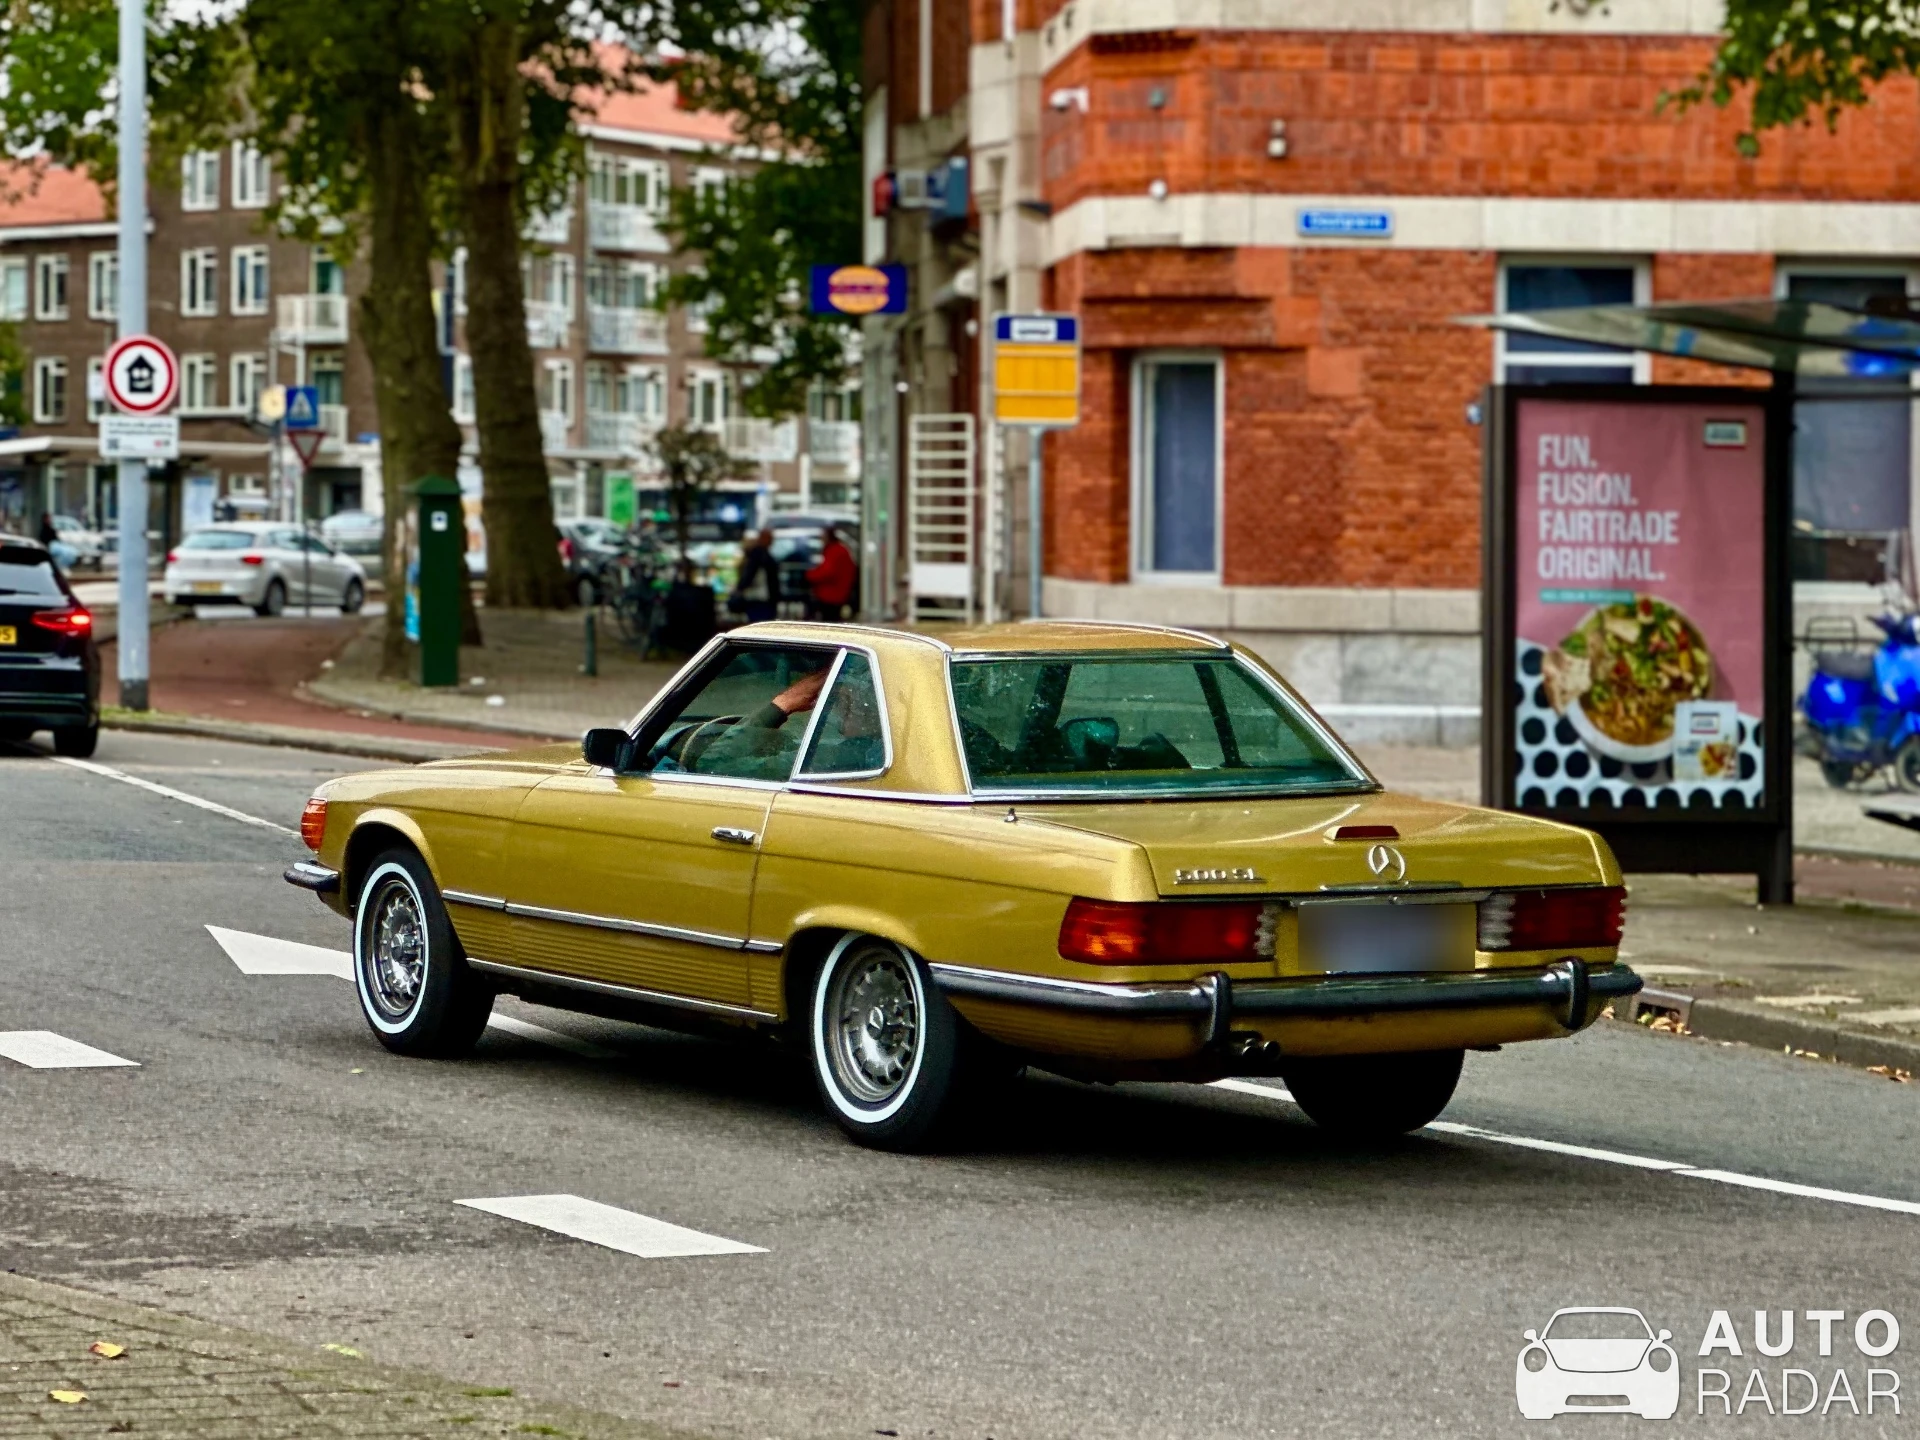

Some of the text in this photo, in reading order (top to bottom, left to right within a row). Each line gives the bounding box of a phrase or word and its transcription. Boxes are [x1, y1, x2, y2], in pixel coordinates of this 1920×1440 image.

[1538, 433, 1598, 468] FUN.
[1538, 471, 1639, 506] FUSION.
[1538, 509, 1679, 544] FAIRTRADE
[1538, 546, 1667, 581] ORIGINAL.
